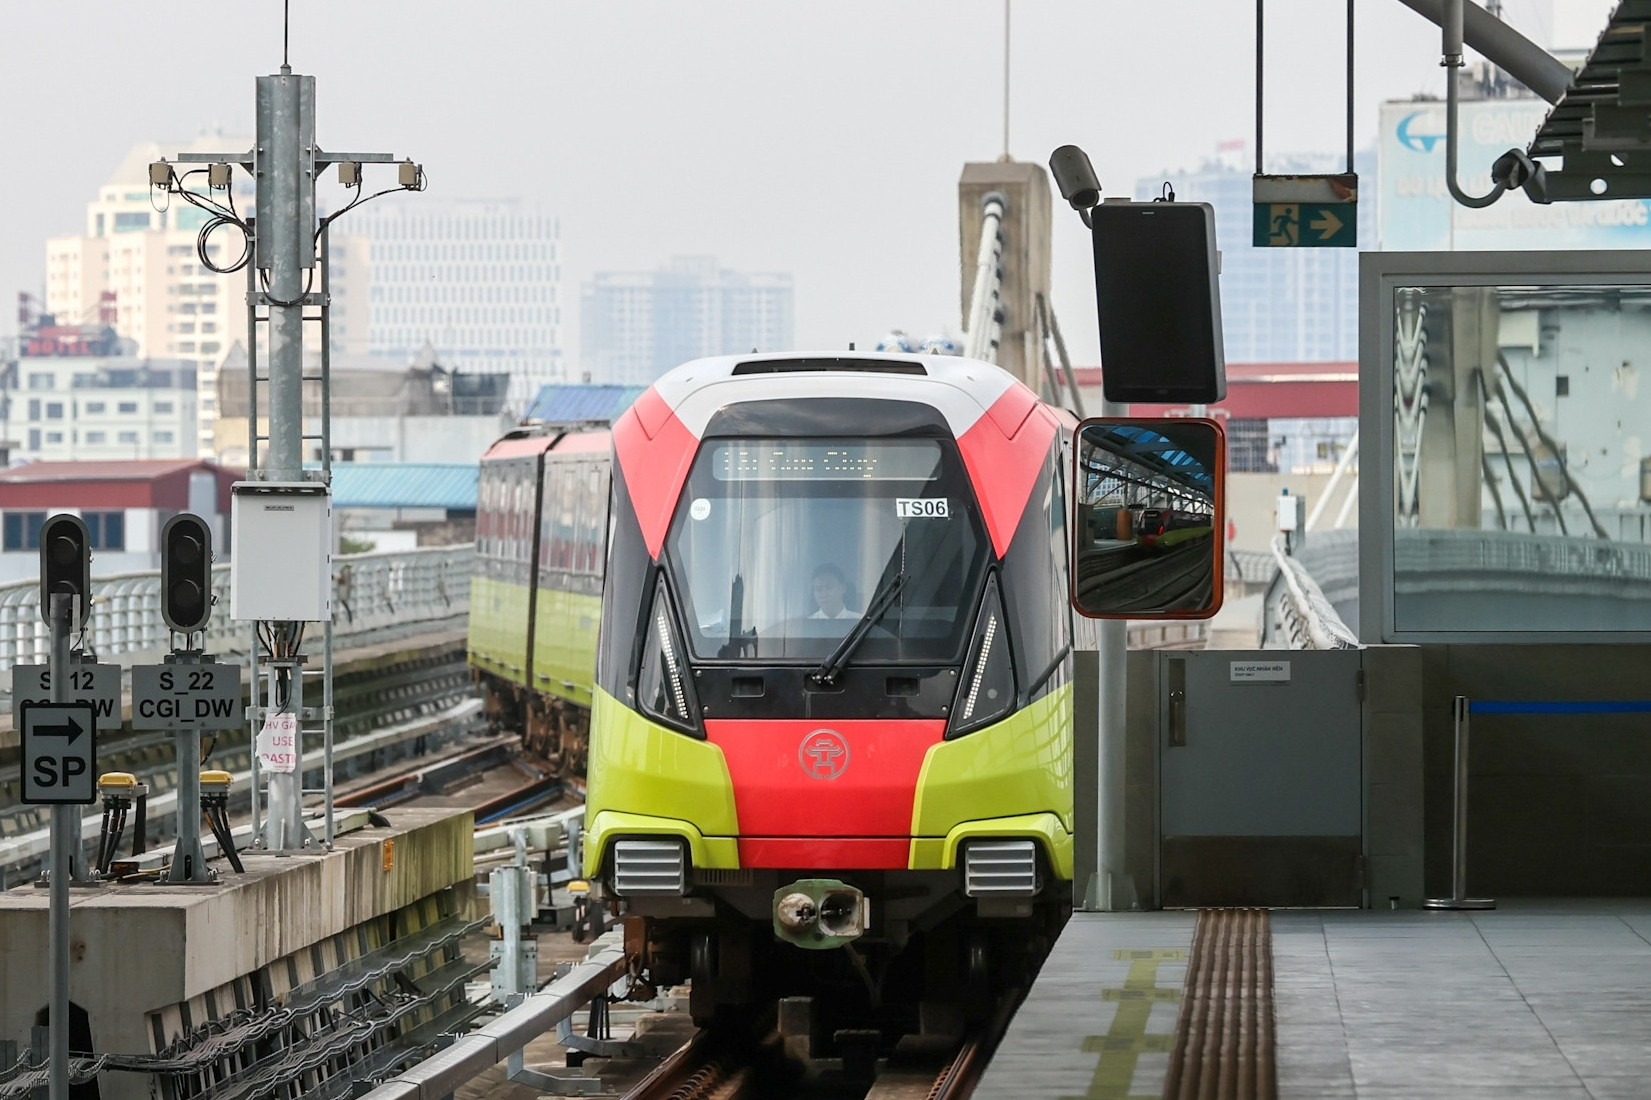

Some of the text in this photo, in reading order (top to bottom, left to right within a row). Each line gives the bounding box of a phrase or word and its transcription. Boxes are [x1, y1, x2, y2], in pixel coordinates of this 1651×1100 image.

[898, 501, 946, 516] TS06
[159, 672, 214, 695] S_22
[138, 699, 234, 723] CGI_DW
[272, 736, 293, 747] USE
[33, 755, 87, 788] SP
